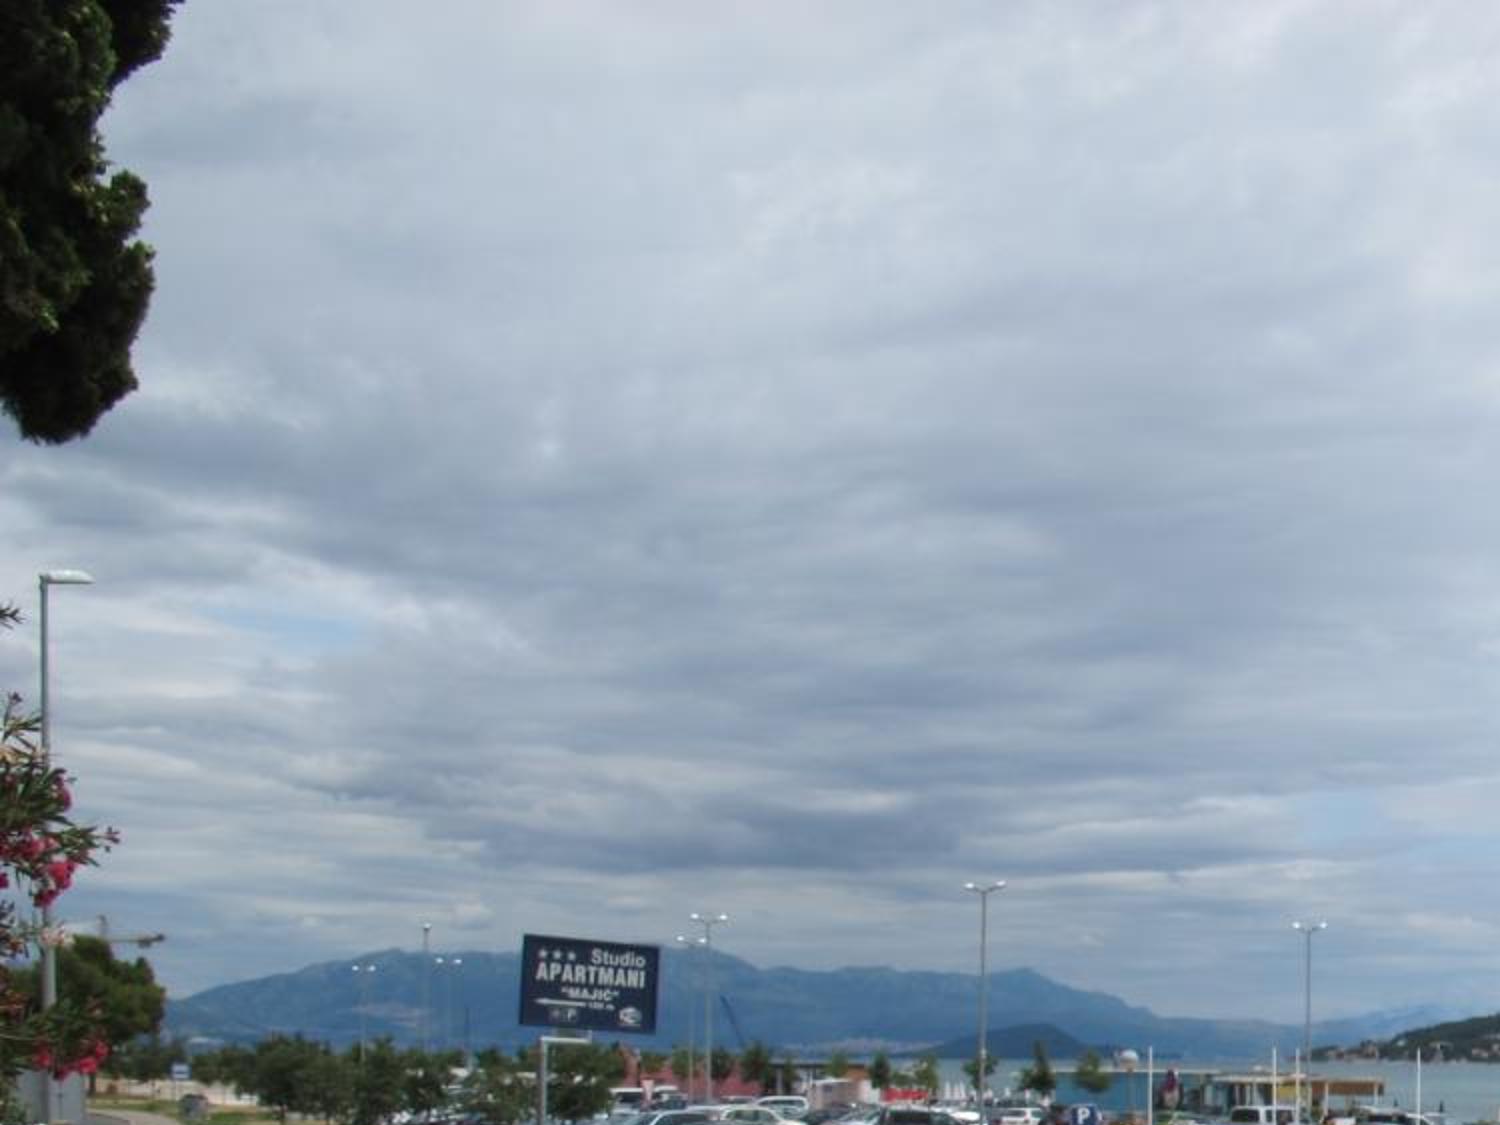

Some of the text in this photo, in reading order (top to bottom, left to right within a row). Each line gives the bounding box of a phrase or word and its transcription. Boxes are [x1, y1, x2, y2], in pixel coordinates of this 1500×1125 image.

[591, 947, 646, 968] Studio
[535, 961, 646, 989] APARTMANI
[1077, 1107, 1091, 1125] P
